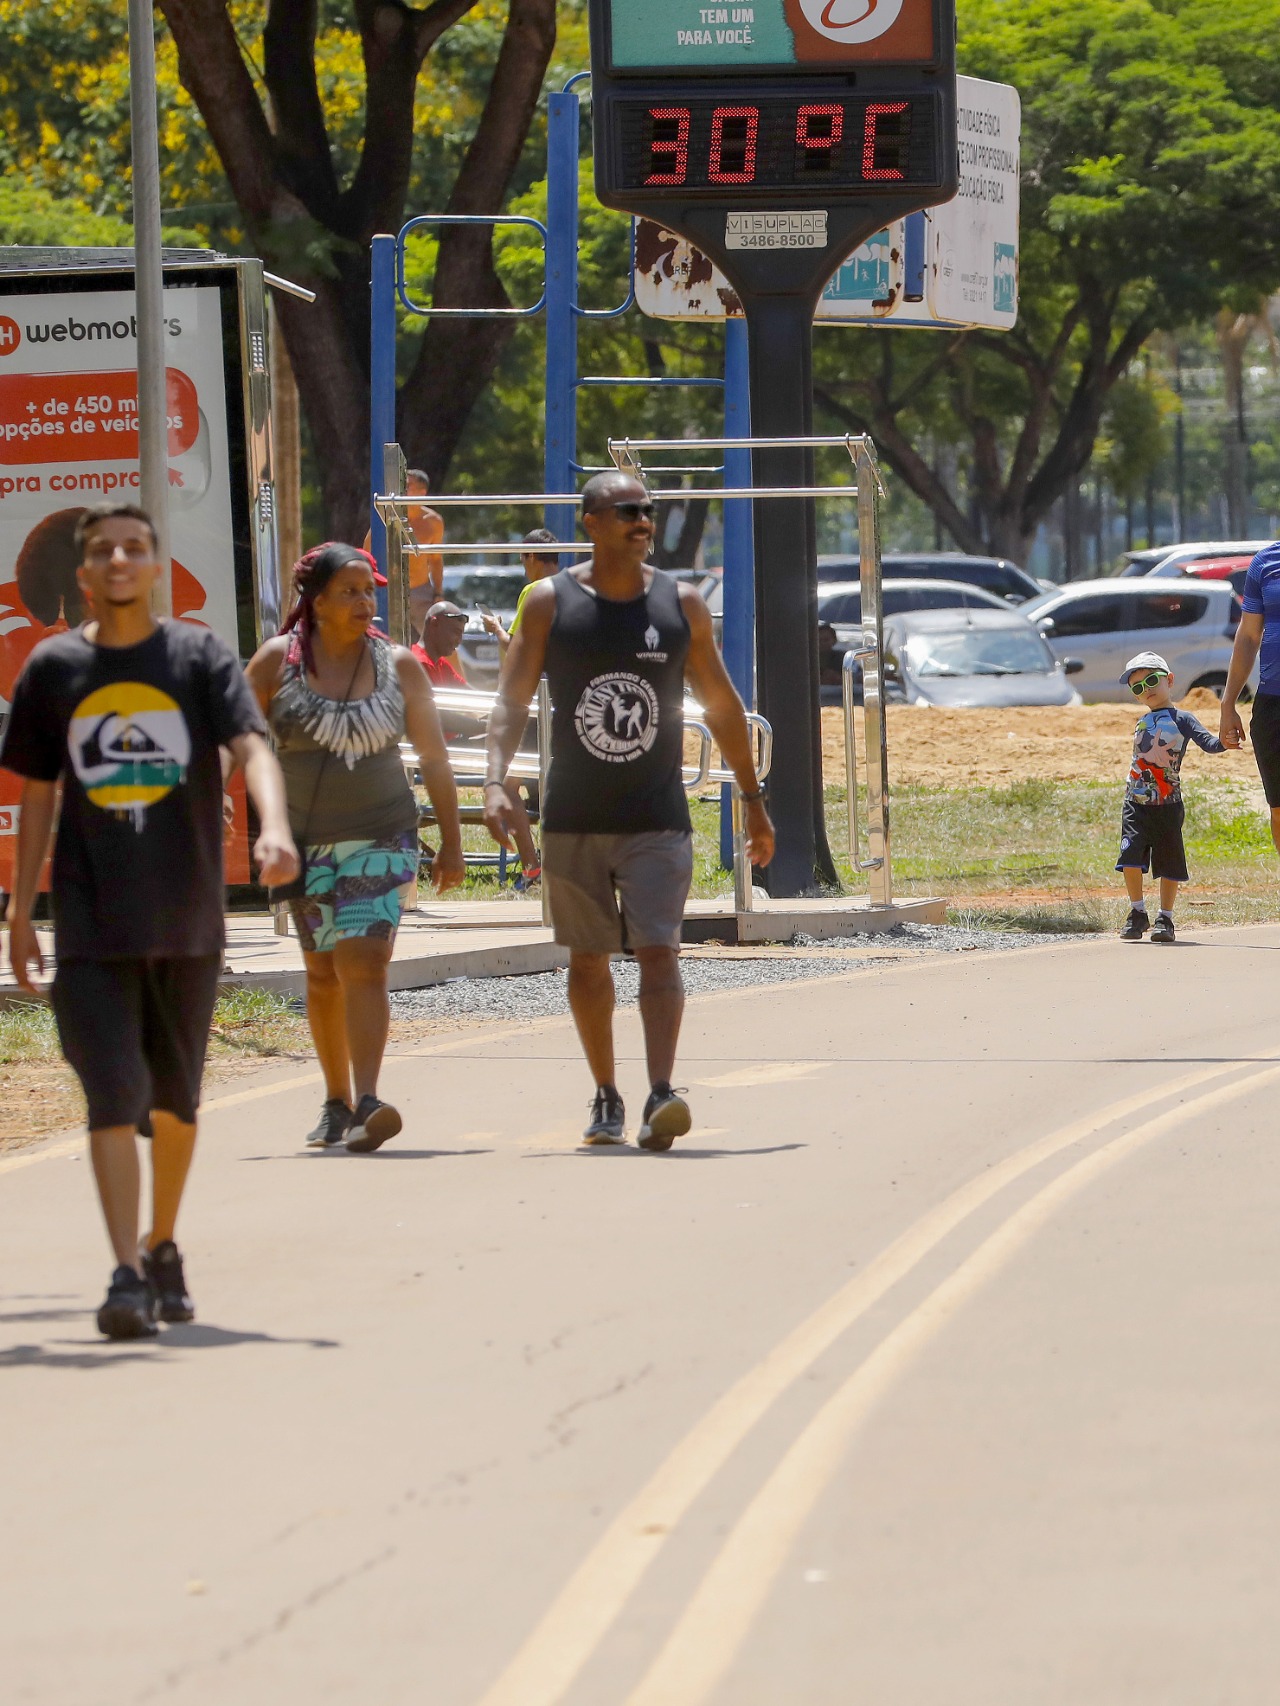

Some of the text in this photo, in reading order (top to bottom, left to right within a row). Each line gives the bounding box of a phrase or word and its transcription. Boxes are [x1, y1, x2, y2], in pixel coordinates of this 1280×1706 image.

[699, 8, 754, 24] TEM UM
[677, 24, 755, 45] PARA VOCÊ.
[643, 106, 760, 186] 30
[730, 219, 826, 229] VISUPLAC
[740, 235, 815, 247] 3486-8500
[26, 315, 182, 343] webmots
[43, 398, 69, 415] de
[74, 396, 112, 414] 450
[118, 394, 138, 412] mi
[70, 416, 95, 433] de
[590, 672, 640, 688] FORMANDO
